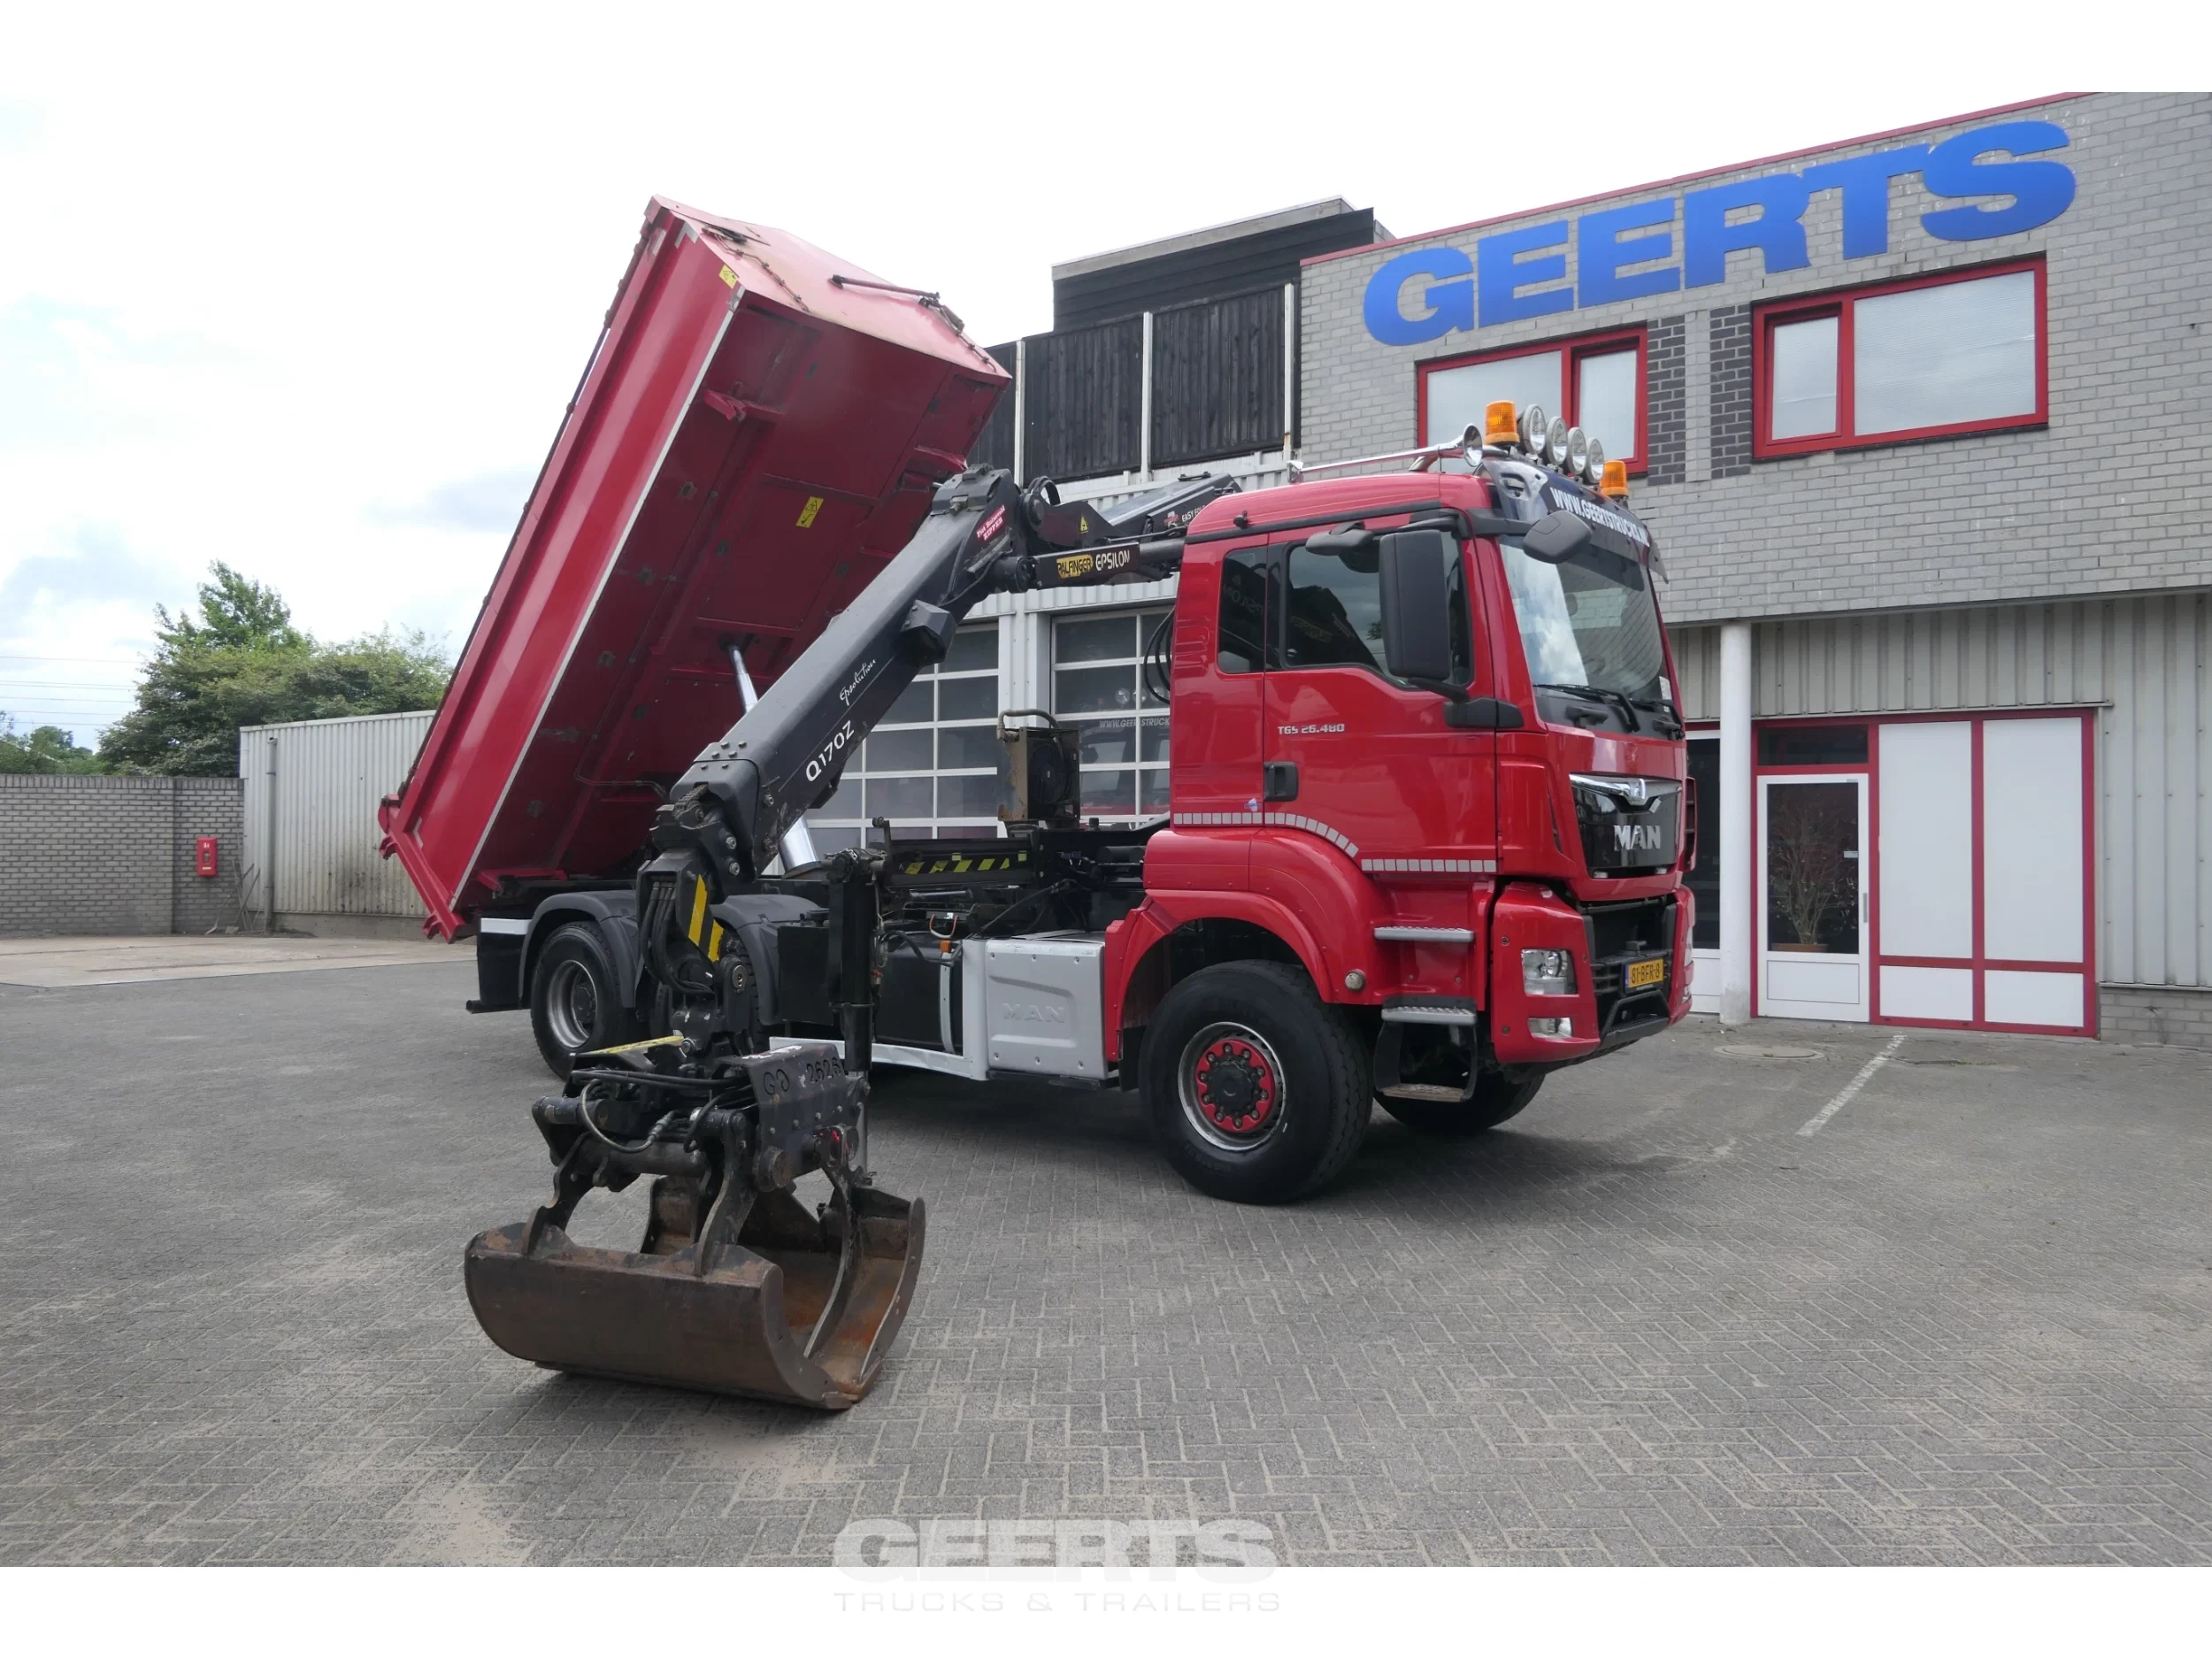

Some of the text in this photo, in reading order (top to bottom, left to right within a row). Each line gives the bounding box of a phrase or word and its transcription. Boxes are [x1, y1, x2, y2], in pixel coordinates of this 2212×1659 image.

[1363, 120, 2076, 347] GEERTS
[1181, 510, 1194, 522] EASY
[1056, 549, 1130, 574] PALFINGER EPSILON
[1278, 724, 1345, 734] TGS 26.480
[806, 720, 855, 781] Q170Z
[1613, 825, 1661, 851] MAN
[1002, 1002, 1065, 1023] MAN
